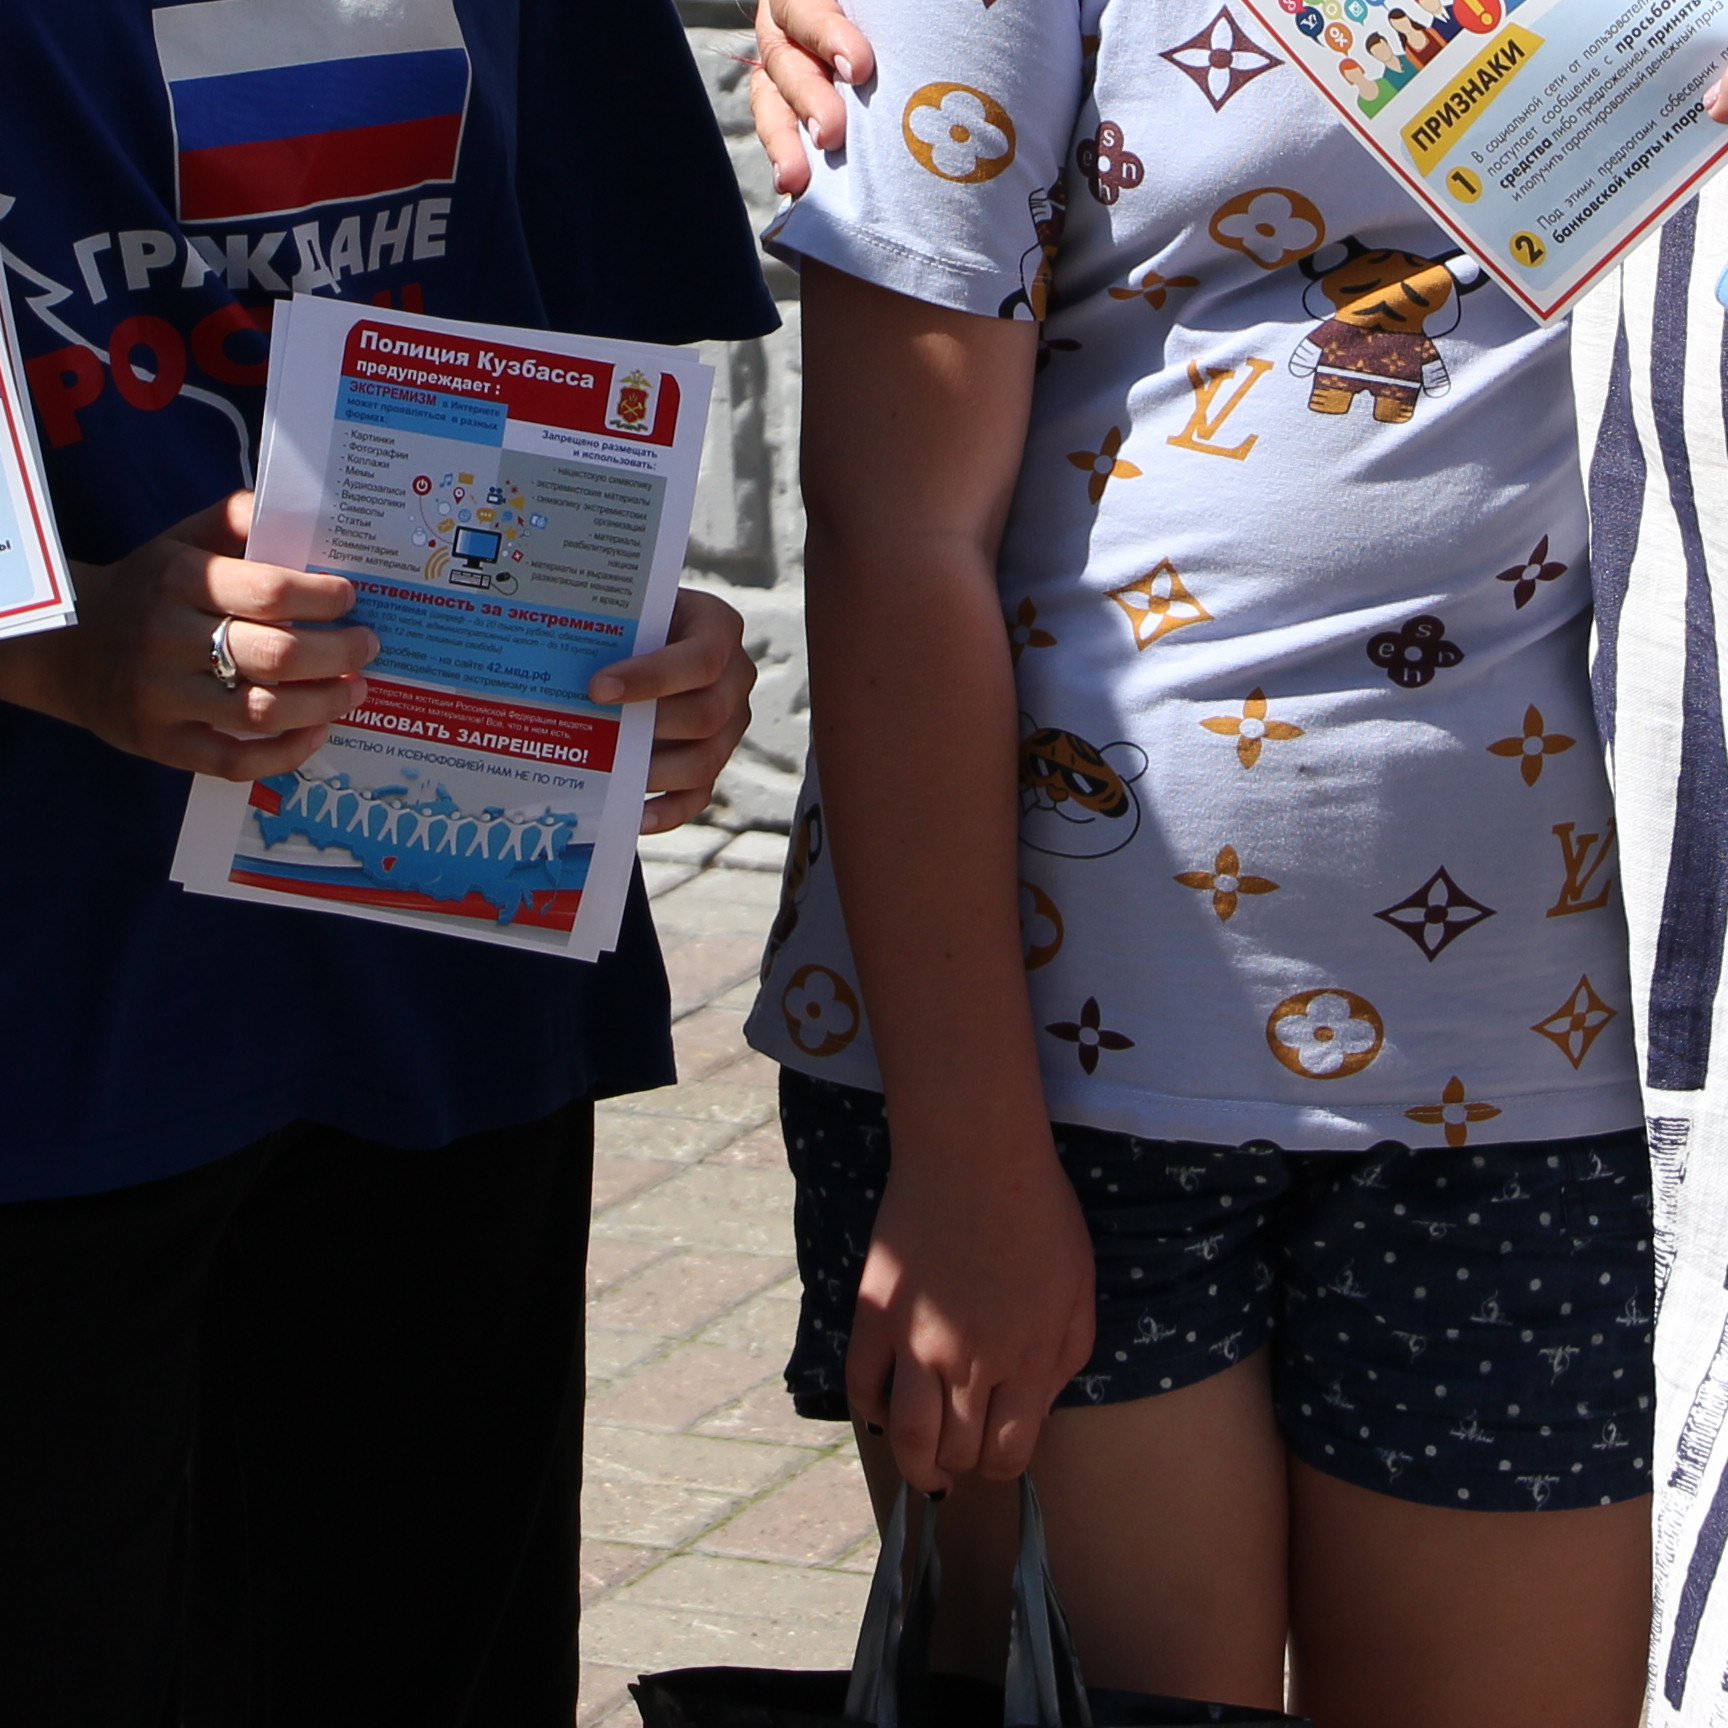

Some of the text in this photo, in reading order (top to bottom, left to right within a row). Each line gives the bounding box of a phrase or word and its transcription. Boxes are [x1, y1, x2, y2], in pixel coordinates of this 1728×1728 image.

[1410, 38, 1526, 152] ПРИЗНАКИ
[1486, 126, 1538, 177] поступает
[1541, 67, 1601, 125] сообщение
[1603, 54, 1614, 66] с
[1499, 137, 1553, 189] средства
[1551, 114, 1578, 142] либо
[1576, 46, 1650, 117] предложением
[1511, 0, 1725, 202] и получить гарантированный денежный приз
[1450, 170, 1477, 195] 1
[1470, 150, 1484, 164] В
[1485, 95, 1544, 154] социальной
[1543, 73, 1568, 97] сети
[1568, 59, 1582, 74] от
[1514, 235, 1544, 264] 2
[1536, 207, 1565, 231] Под
[1564, 177, 1596, 208] этими
[1597, 119, 1658, 177] предлогами
[1659, 61, 1720, 118] собеседник
[1552, 102, 1706, 244] банковской карты и паро
[73, 197, 452, 305] ГРАЖДАНЕ
[356, 360, 492, 394] предупреждает
[360, 329, 595, 389] Полиция Кузбасса
[349, 380, 437, 406] ЭКСТРЕМИЗМ
[348, 441, 409, 460] Фотографии
[350, 429, 396, 446] Картинки
[541, 429, 658, 459] Запрещено размещать
[480, 603, 503, 617] за
[507, 607, 625, 637] экстремизм:
[341, 708, 589, 764] ЛИКОВАТЬ ЗАПРЕЩЕНО!
[385, 745, 396, 756] И
[396, 747, 485, 773] КСЕНОФОБИЕЙ
[486, 764, 512, 778] НАМ
[514, 769, 531, 782] НЕ
[532, 772, 551, 785] ПО
[552, 775, 585, 790] ПУТИ!
